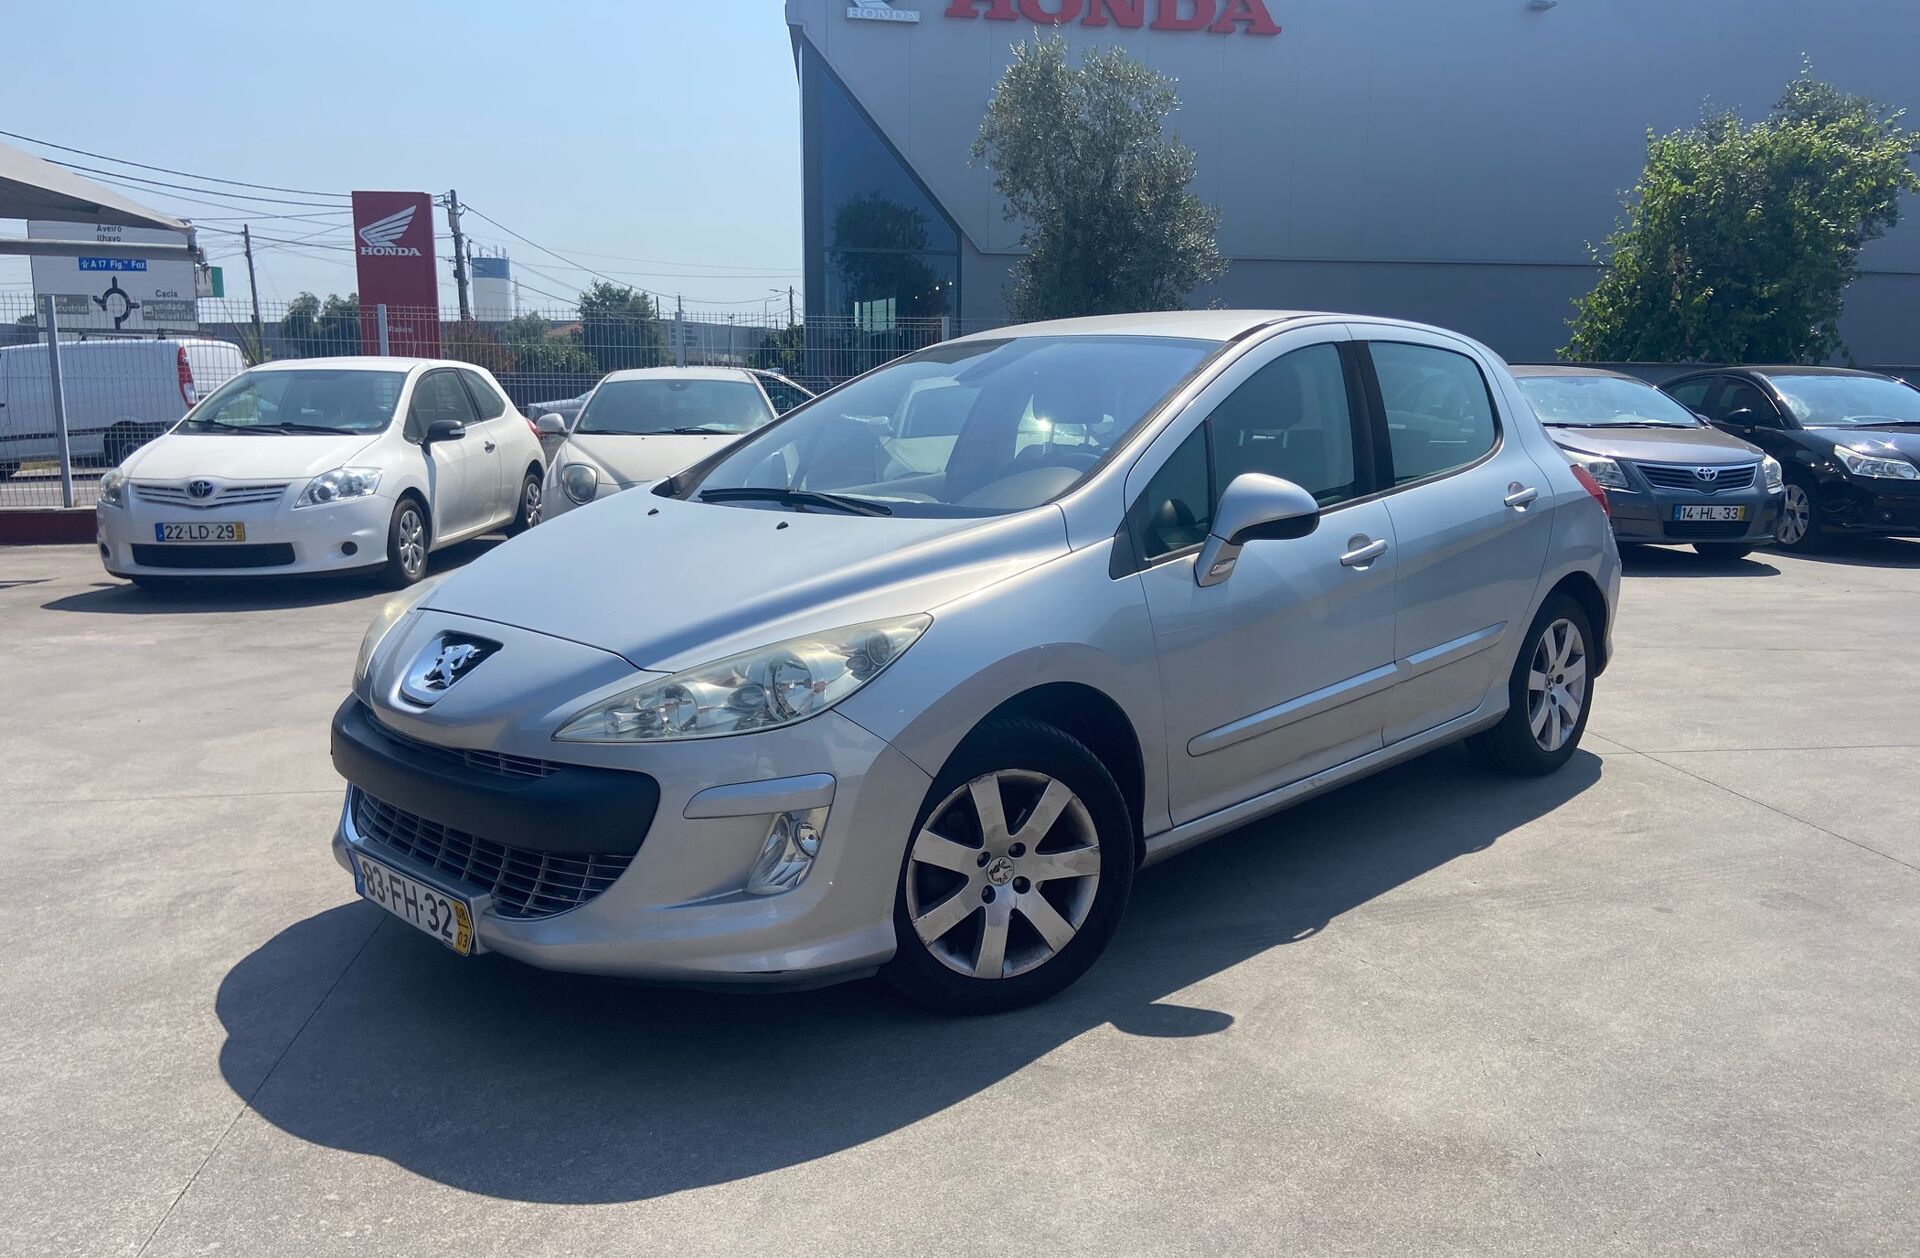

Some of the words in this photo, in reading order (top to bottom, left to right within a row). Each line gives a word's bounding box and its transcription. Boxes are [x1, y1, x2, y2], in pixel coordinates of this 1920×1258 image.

[847, 8, 918, 22] HONDA
[96, 223, 122, 233] Aveiro
[360, 247, 422, 256] HONDA
[131, 260, 145, 270] Foz
[155, 288, 178, 298] Cacia
[457, 931, 468, 948] 03
